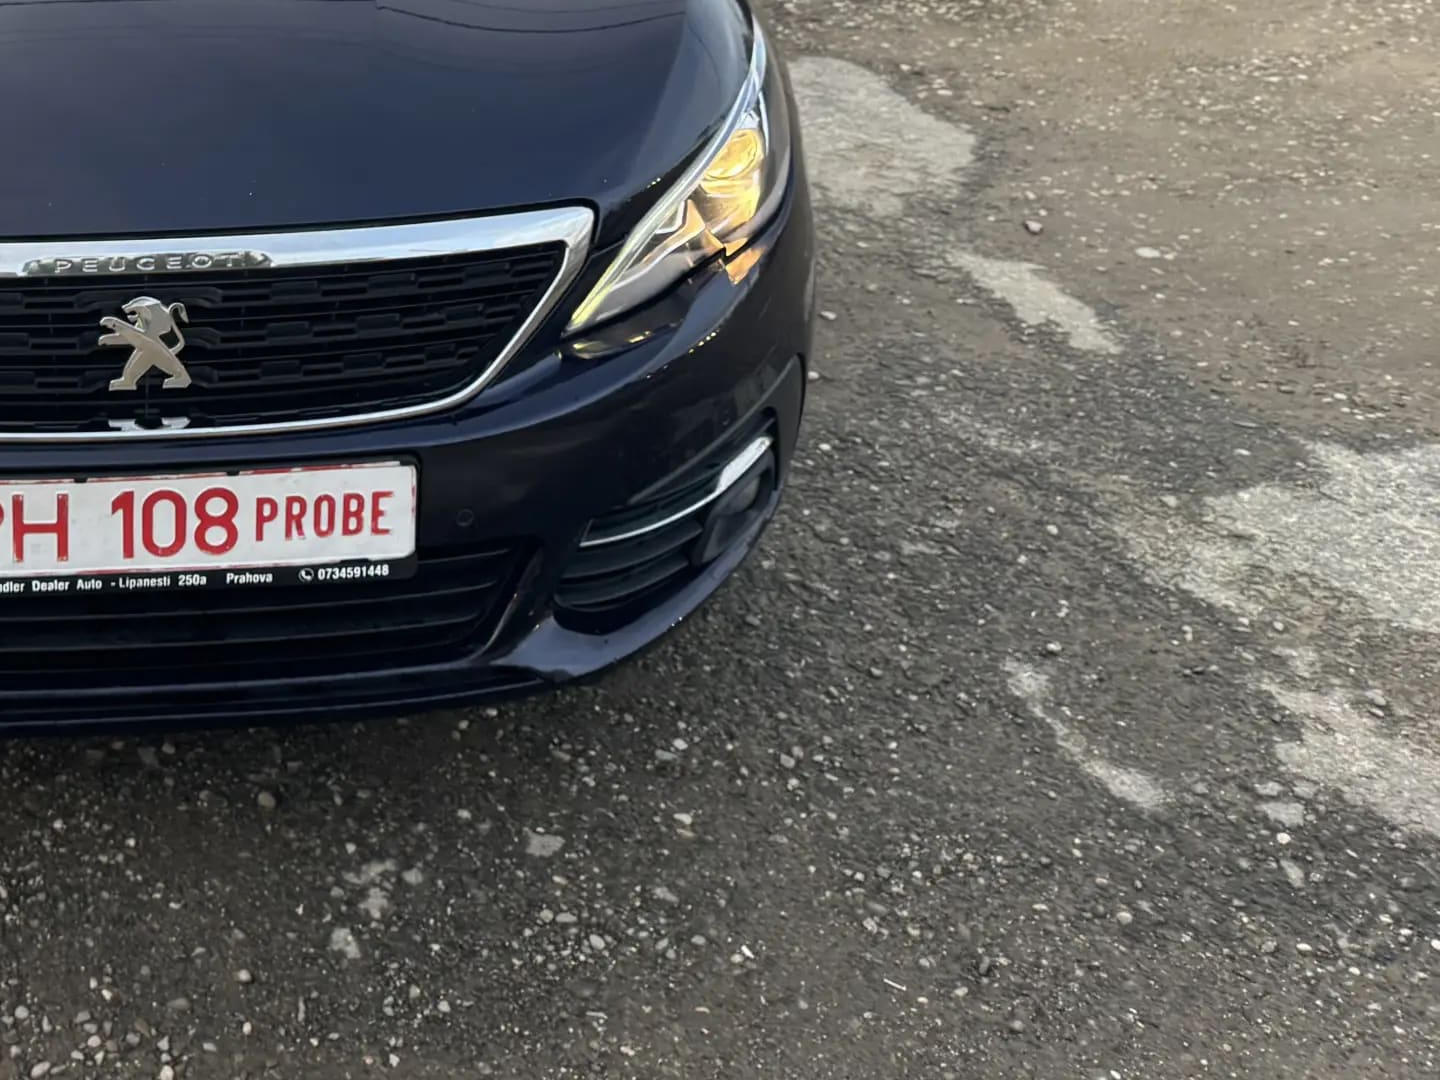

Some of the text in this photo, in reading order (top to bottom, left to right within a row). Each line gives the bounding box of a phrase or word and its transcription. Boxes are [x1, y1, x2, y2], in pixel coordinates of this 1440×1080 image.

[53, 253, 241, 274] PEUGEOT
[110, 486, 239, 560] 108
[255, 489, 395, 543] PROBE
[31, 578, 70, 593] Dealer
[76, 577, 103, 591] Auto
[118, 574, 172, 590] Lipanesti
[177, 574, 208, 587] 250a
[225, 571, 274, 585] Prahova
[317, 563, 390, 581] 0734591448
